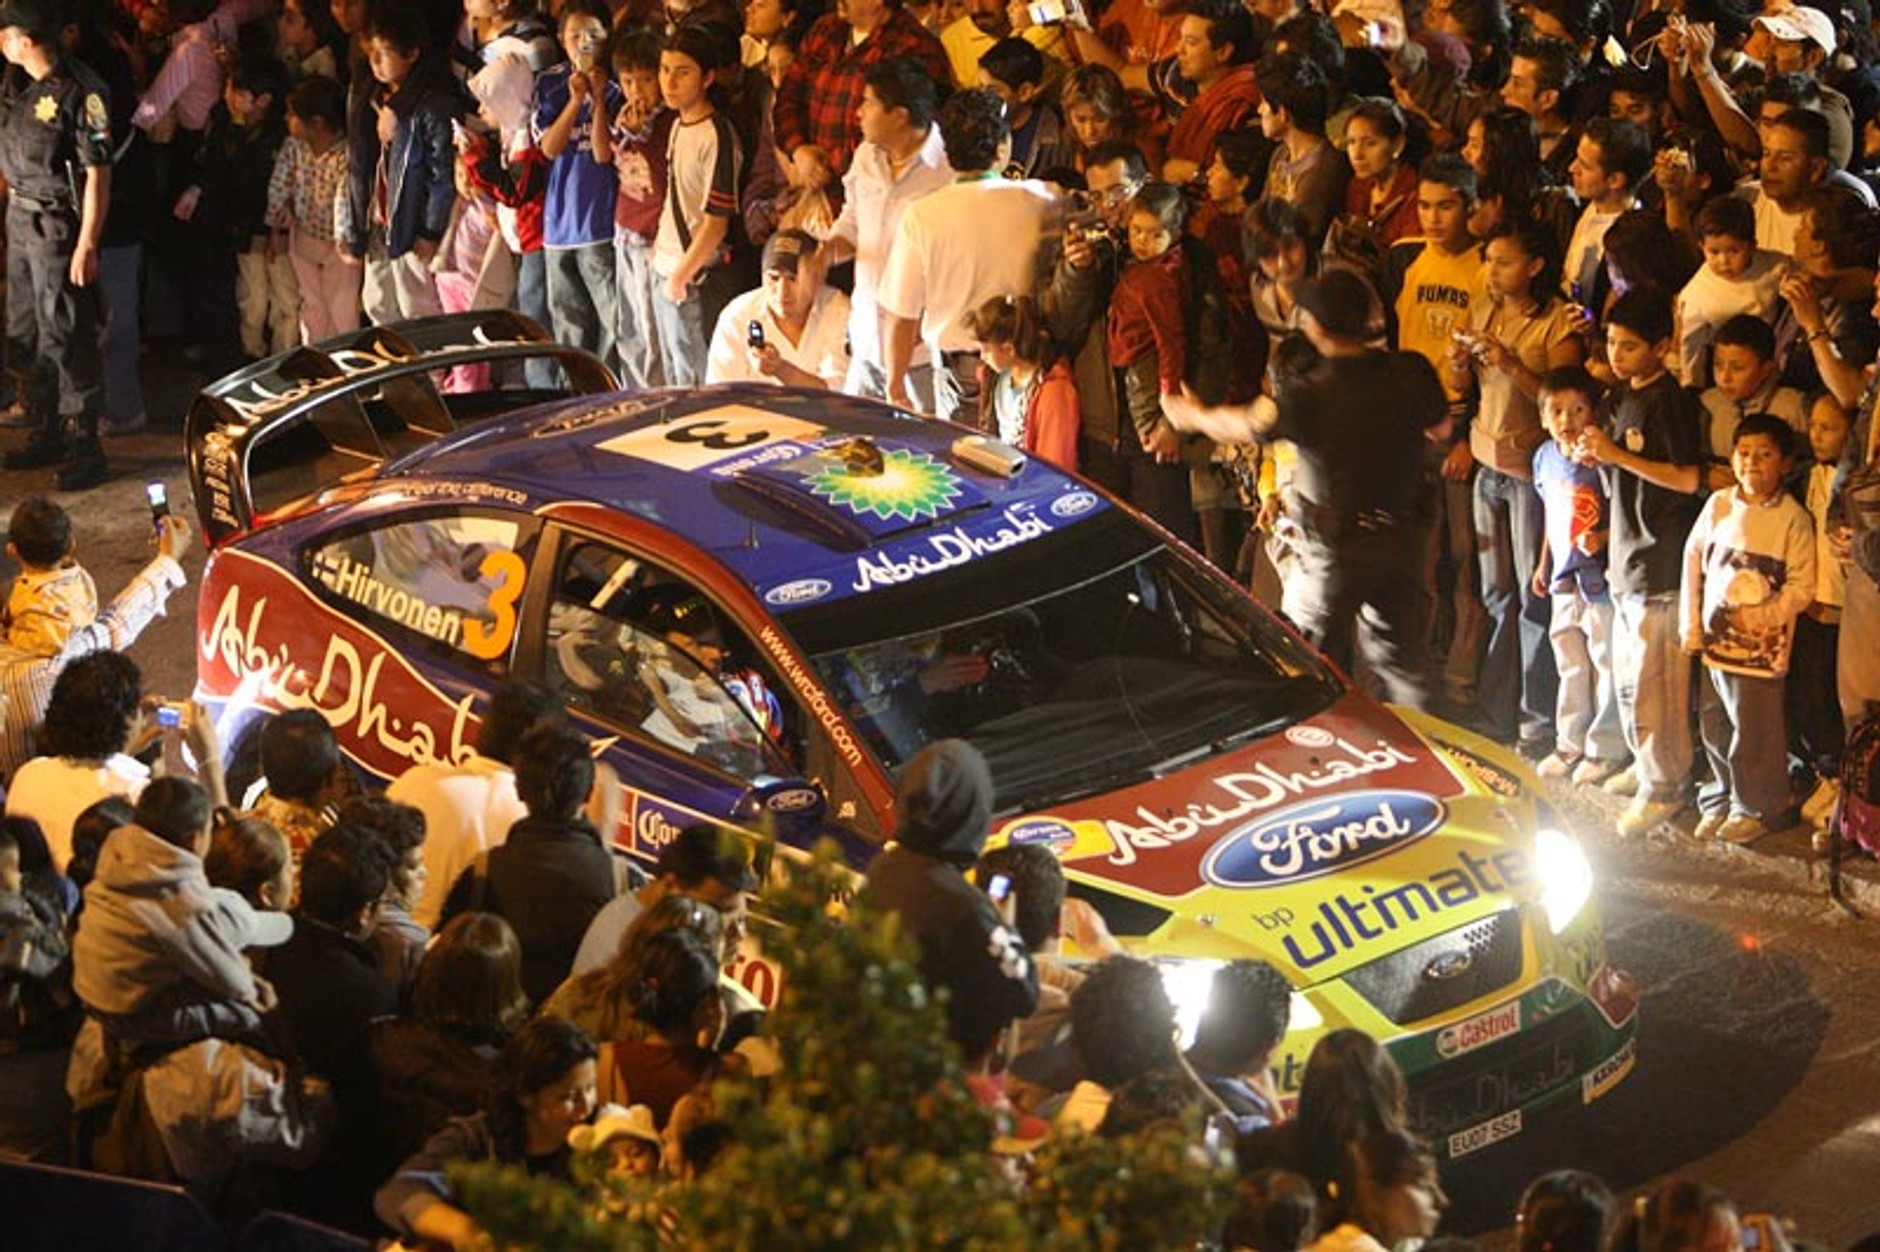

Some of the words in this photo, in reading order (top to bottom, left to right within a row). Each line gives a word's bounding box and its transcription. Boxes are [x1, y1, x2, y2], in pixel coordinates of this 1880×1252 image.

[1417, 284, 1469, 310] PUMAS
[336, 556, 461, 646] Hirvonen
[463, 551, 526, 660] 3
[1250, 802, 1411, 876] Ford
[1252, 906, 1294, 931] bp
[1282, 850, 1537, 969] ultimate
[1459, 1005, 1518, 1048] Castrol
[1452, 1126, 1490, 1152] EU07
